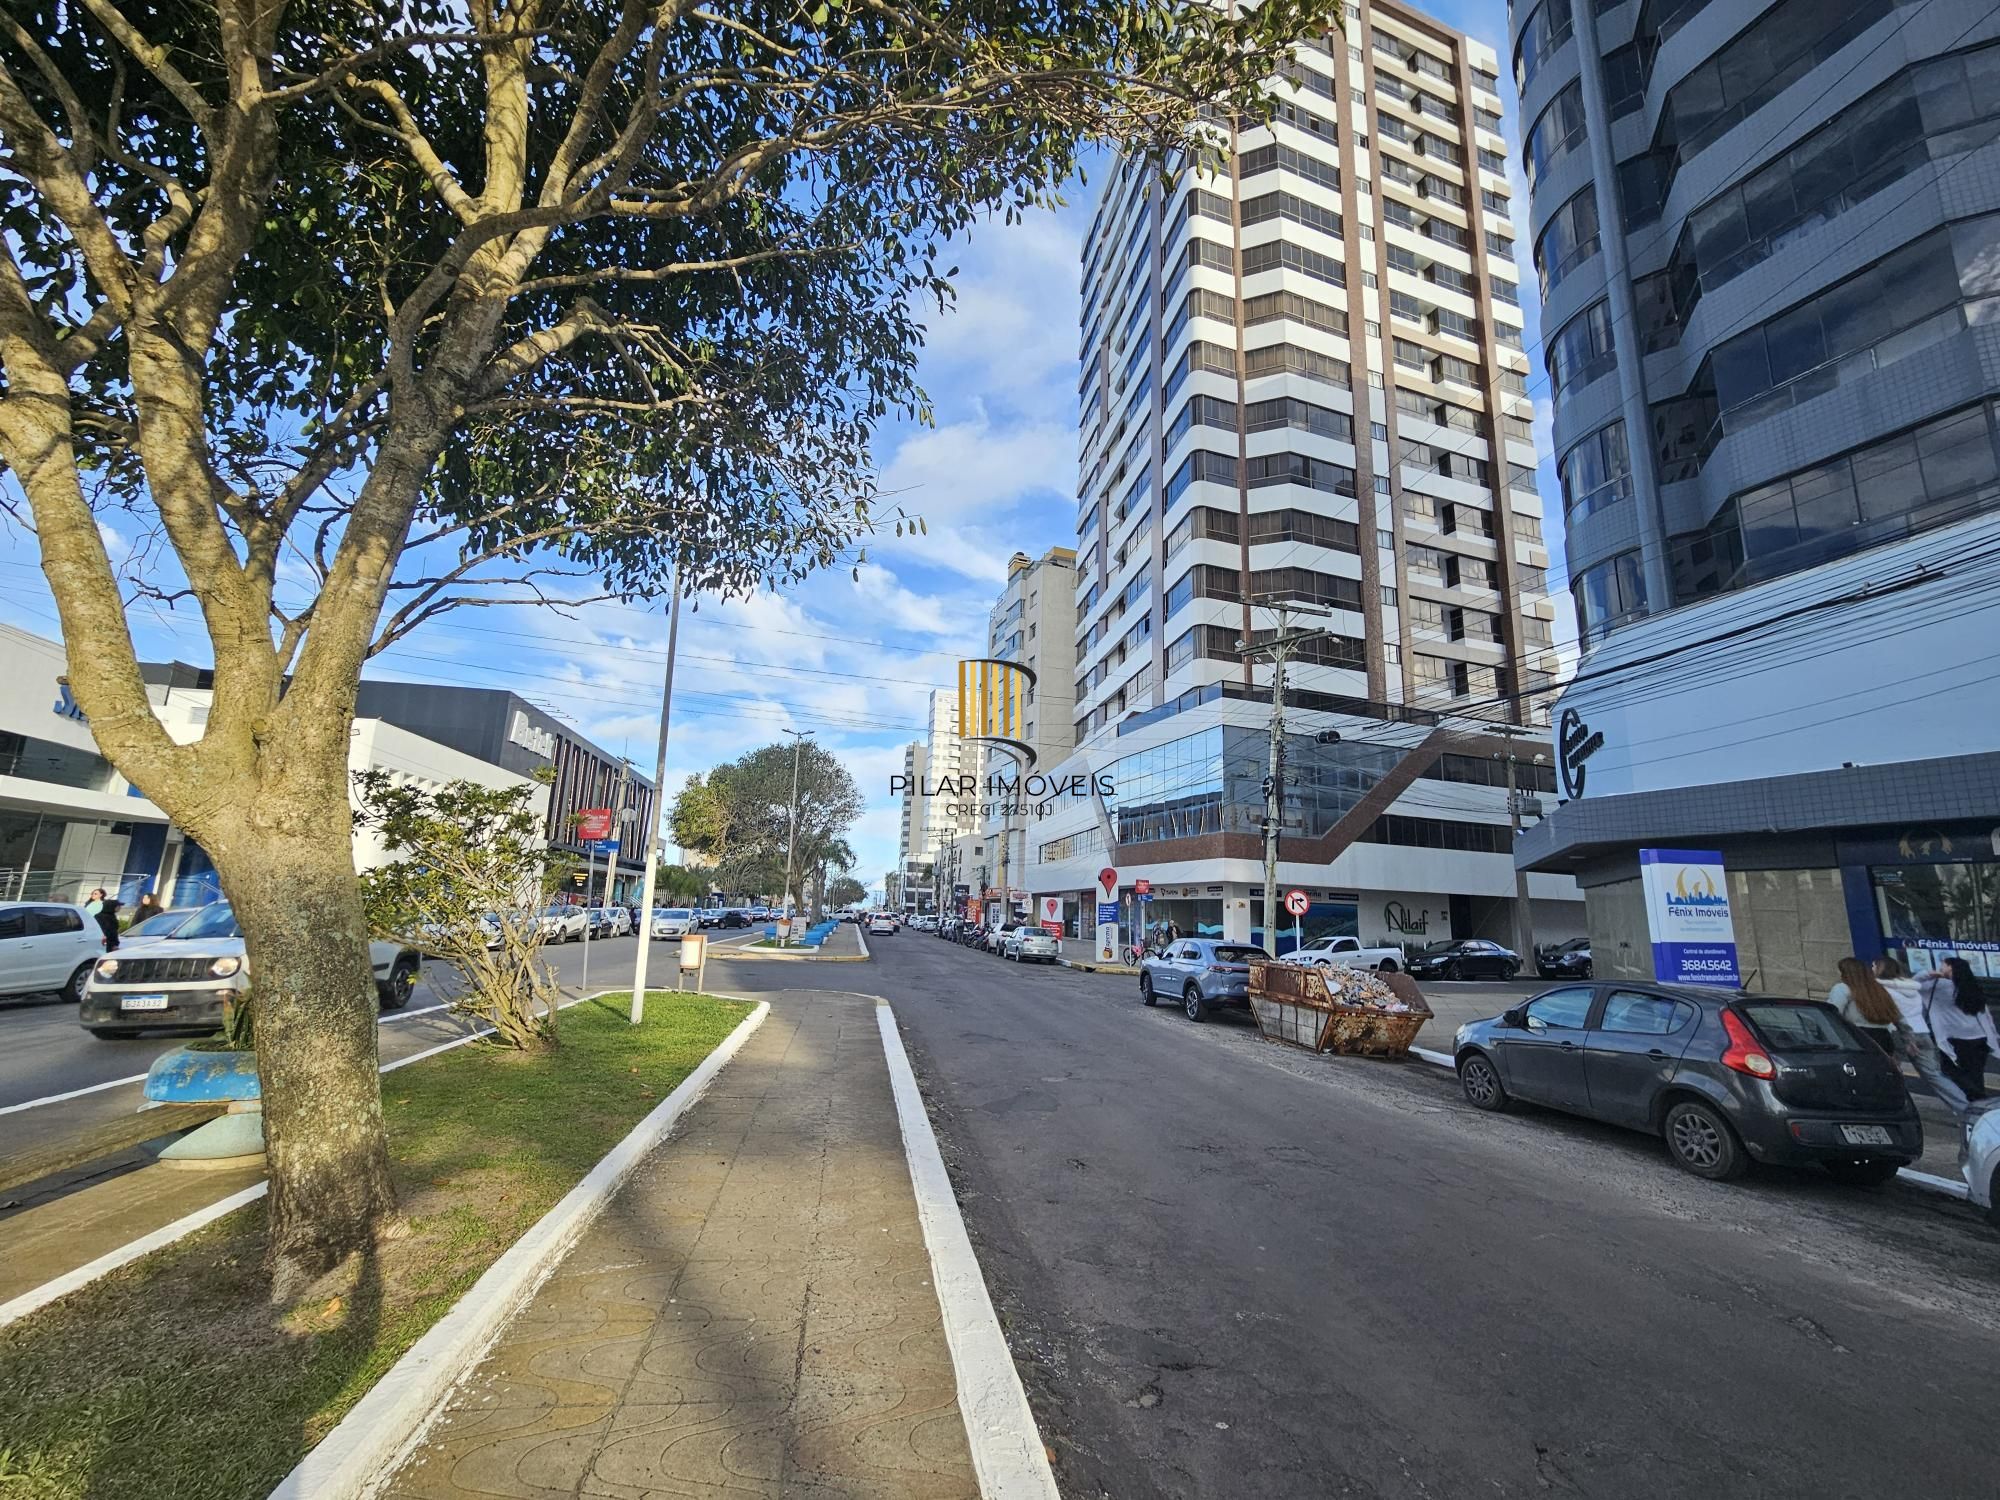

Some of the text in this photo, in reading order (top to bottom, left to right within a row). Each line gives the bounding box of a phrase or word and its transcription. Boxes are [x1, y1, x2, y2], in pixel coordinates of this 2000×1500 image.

[1668, 906, 1729, 918] Fênix Imóveis
[1918, 939, 1999, 951] Fênix Imóveis
